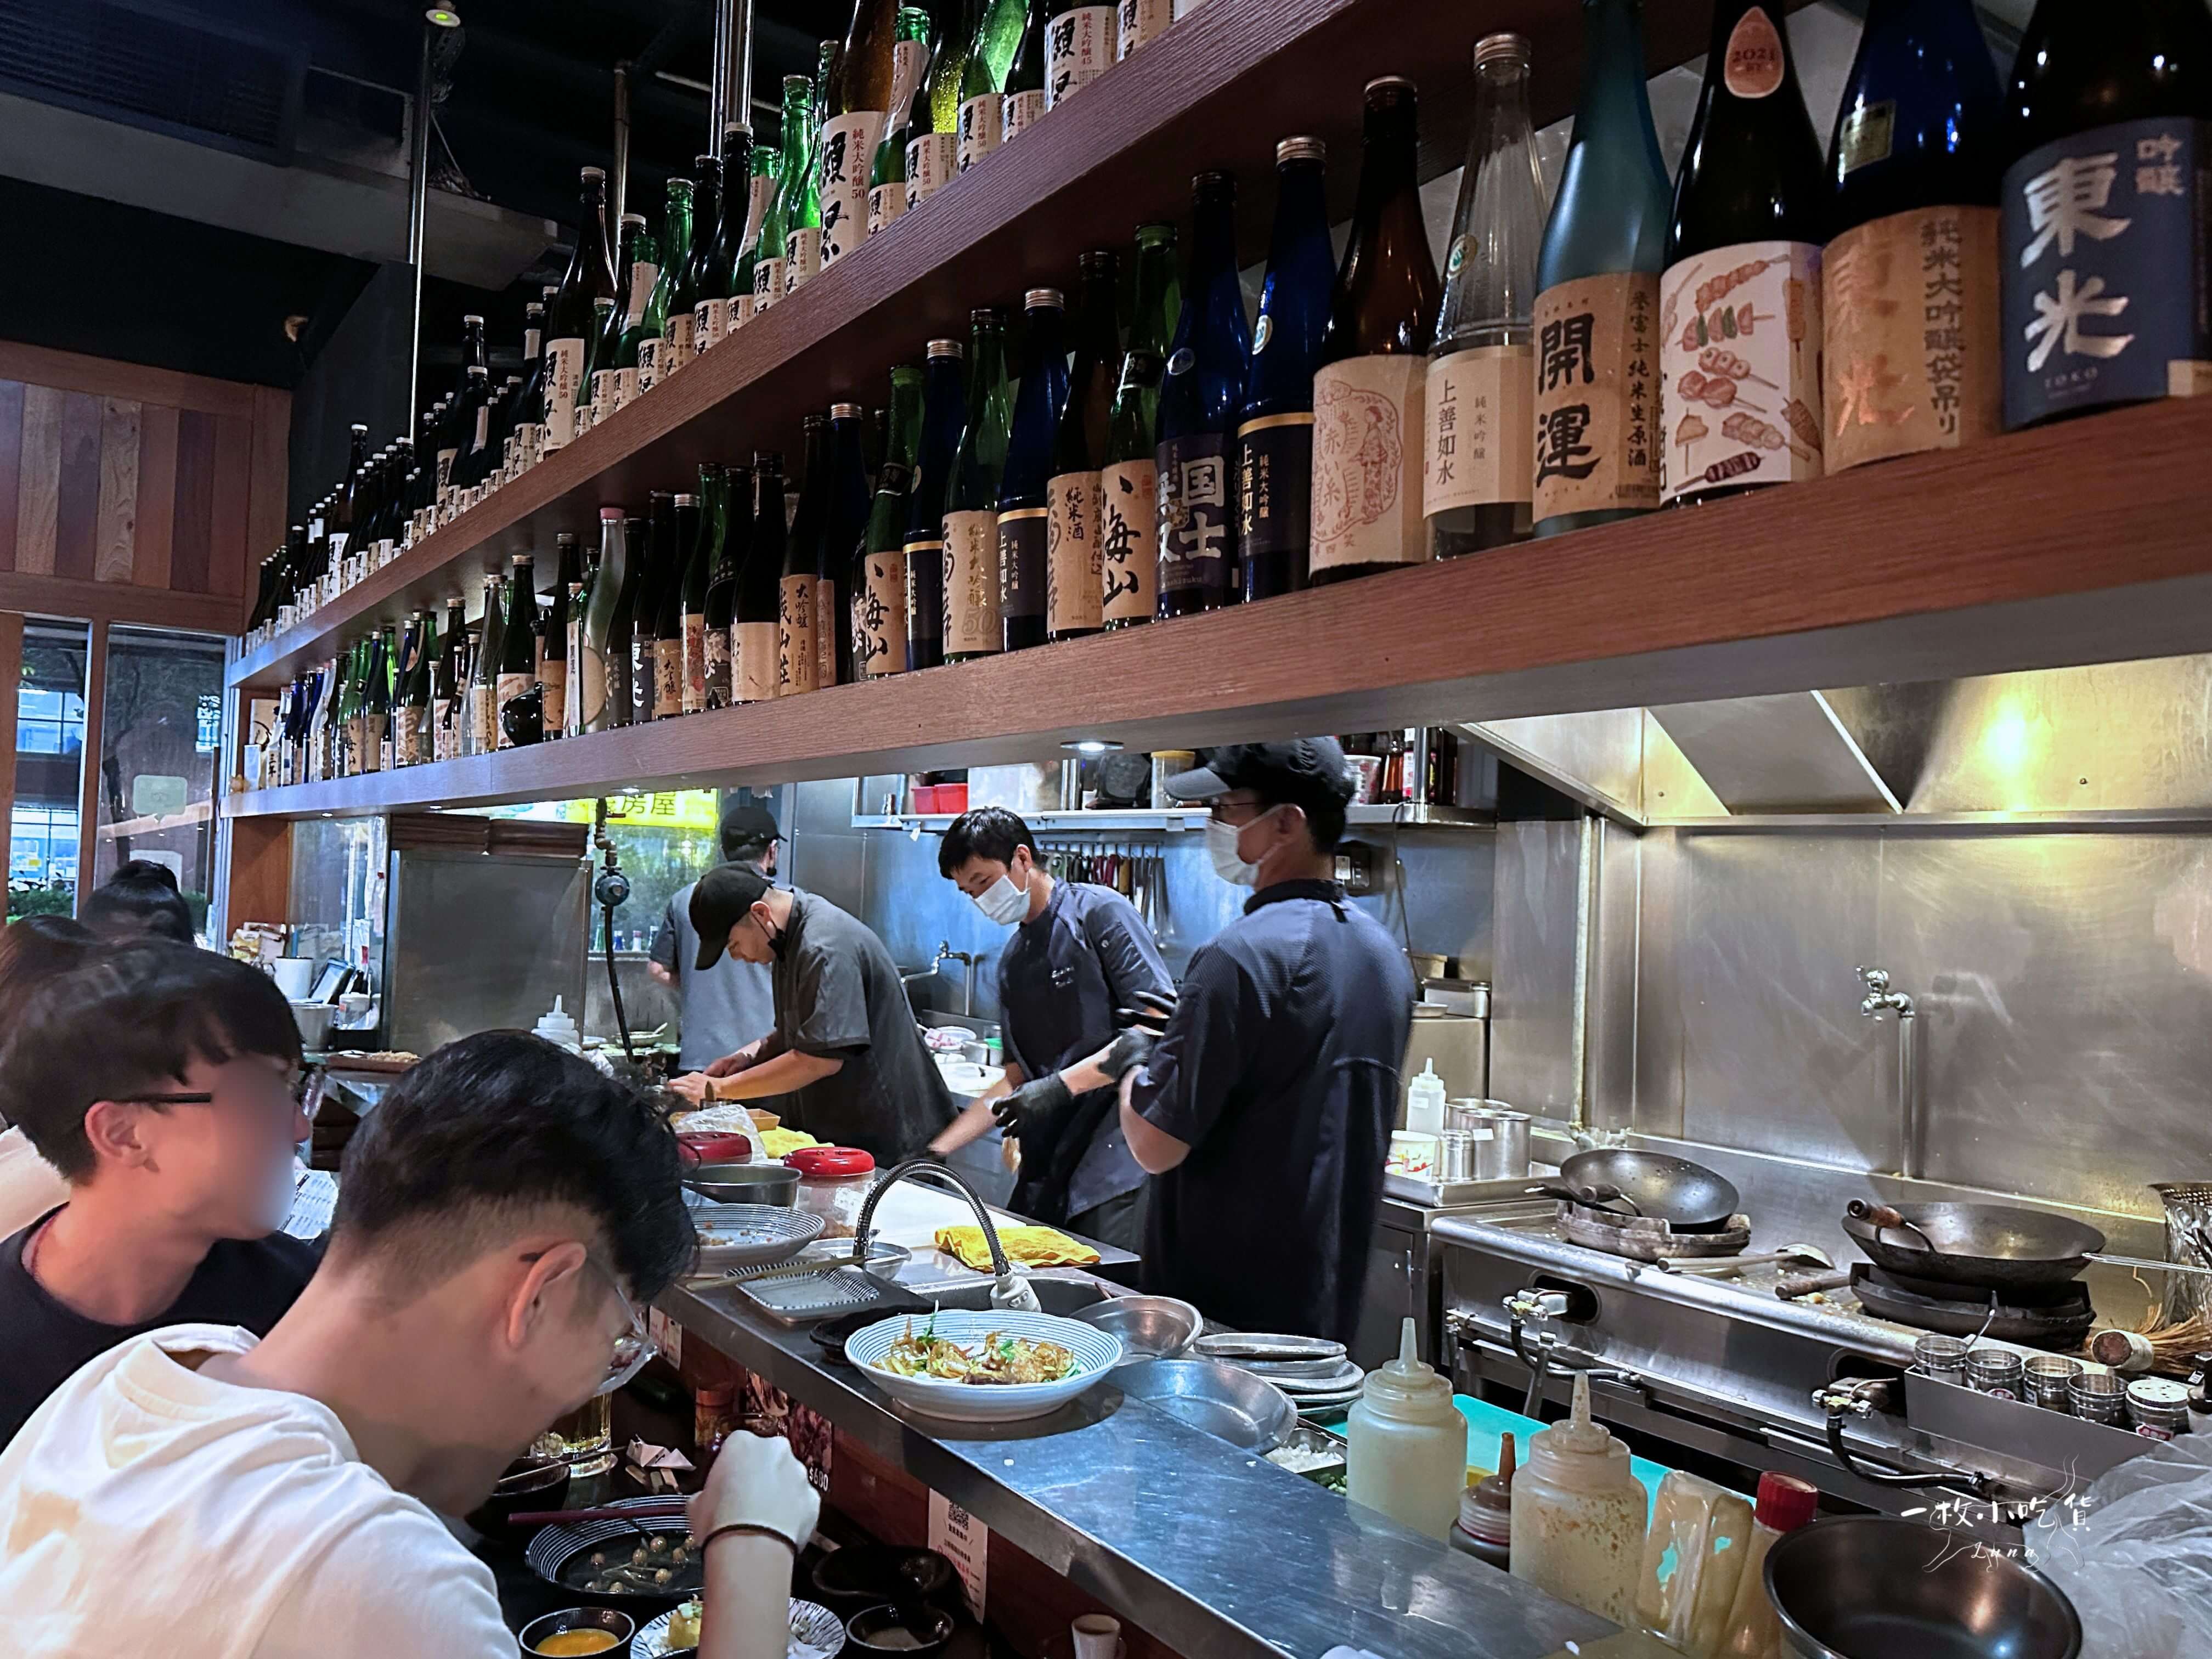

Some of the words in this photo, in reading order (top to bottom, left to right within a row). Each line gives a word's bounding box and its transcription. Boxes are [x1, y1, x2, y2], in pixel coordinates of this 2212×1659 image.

[851, 129, 865, 199] 純米大吟醸50
[2136, 134, 2186, 196] 吟醸
[2021, 152, 2135, 373] 東光
[1921, 219, 1965, 435] 純米大吟醸袋吊り
[1431, 379, 1457, 486] 上善如水
[1474, 396, 1487, 459] 純米吟醸
[1536, 313, 1601, 488] 開運
[1065, 487, 1084, 541] 純米酒
[1242, 443, 1253, 536] 上善如水
[1259, 454, 1269, 518] 純米大吟醸
[999, 531, 1008, 603] 上善如水
[796, 583, 809, 628] 大吟醸
[962, 610, 997, 635] 50
[606, 793, 676, 815] 房屋
[809, 1467, 828, 1491] $680
